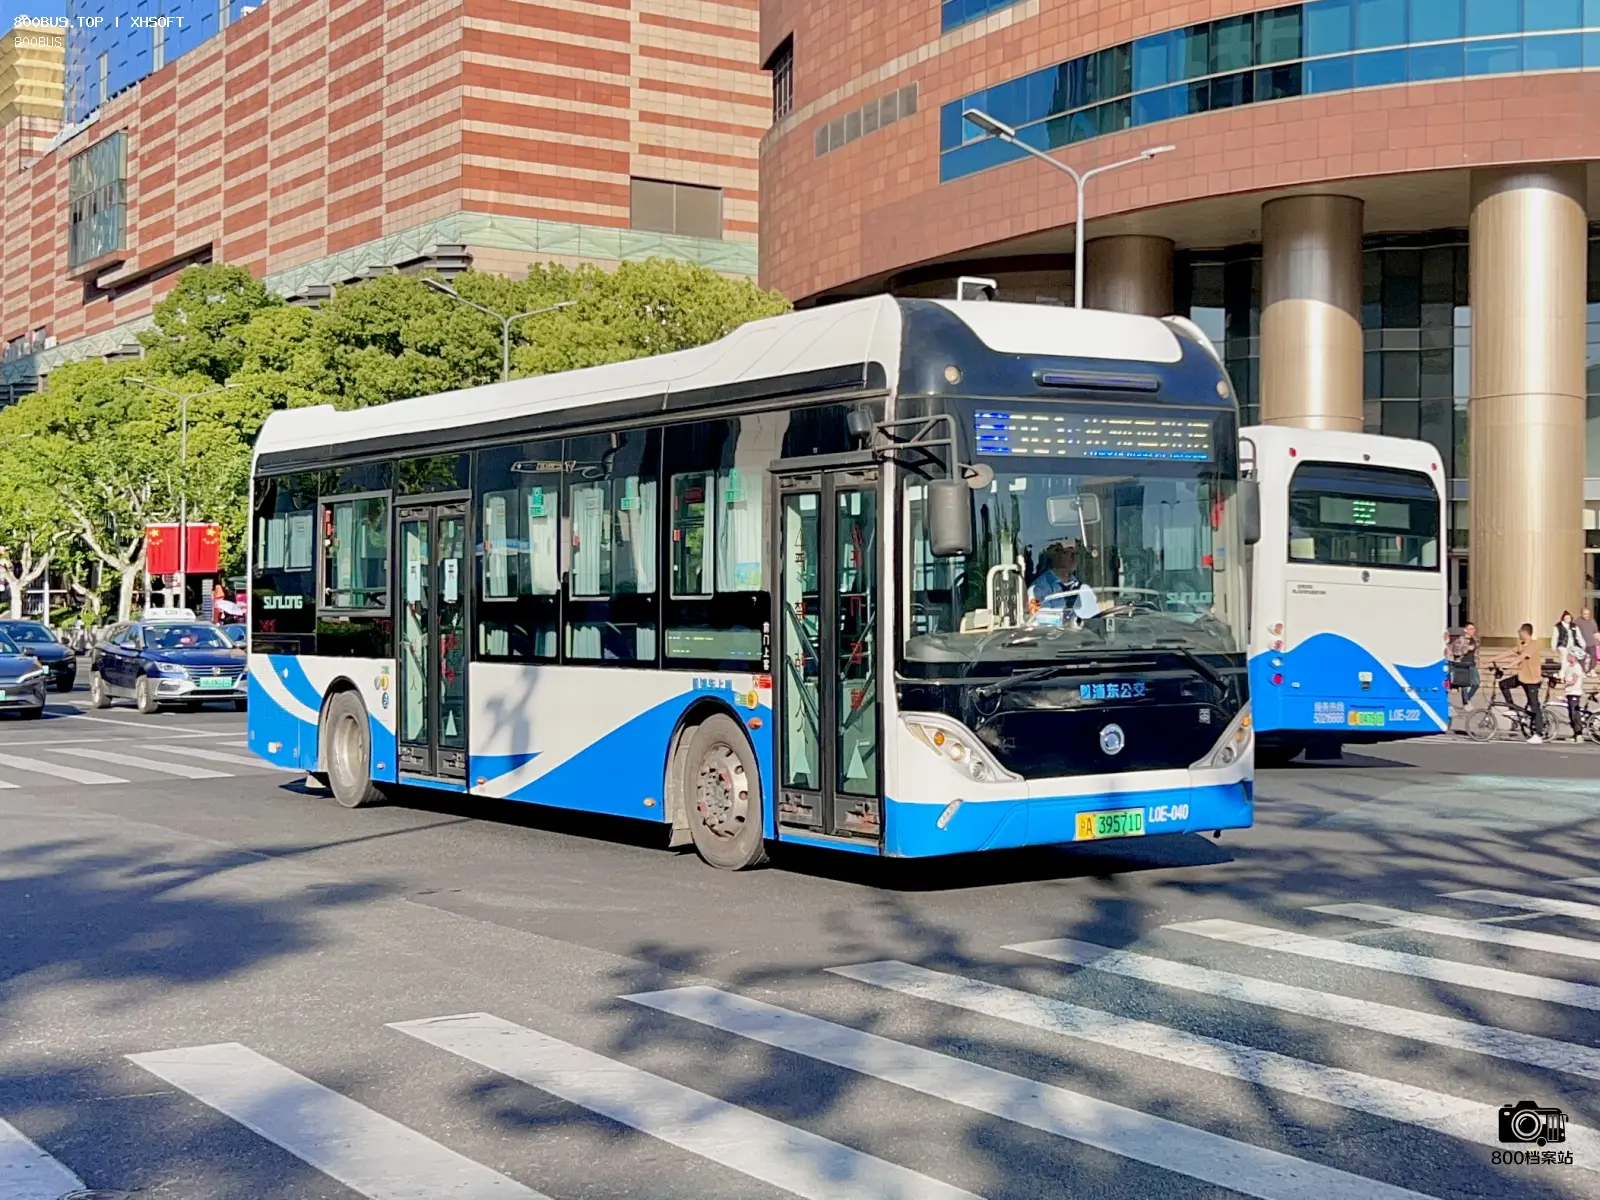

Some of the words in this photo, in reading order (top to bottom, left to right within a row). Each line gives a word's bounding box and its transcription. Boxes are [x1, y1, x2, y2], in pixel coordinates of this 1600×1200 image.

[263, 595, 303, 609] SUNLONG
[1091, 682, 1146, 700] 浦东公交
